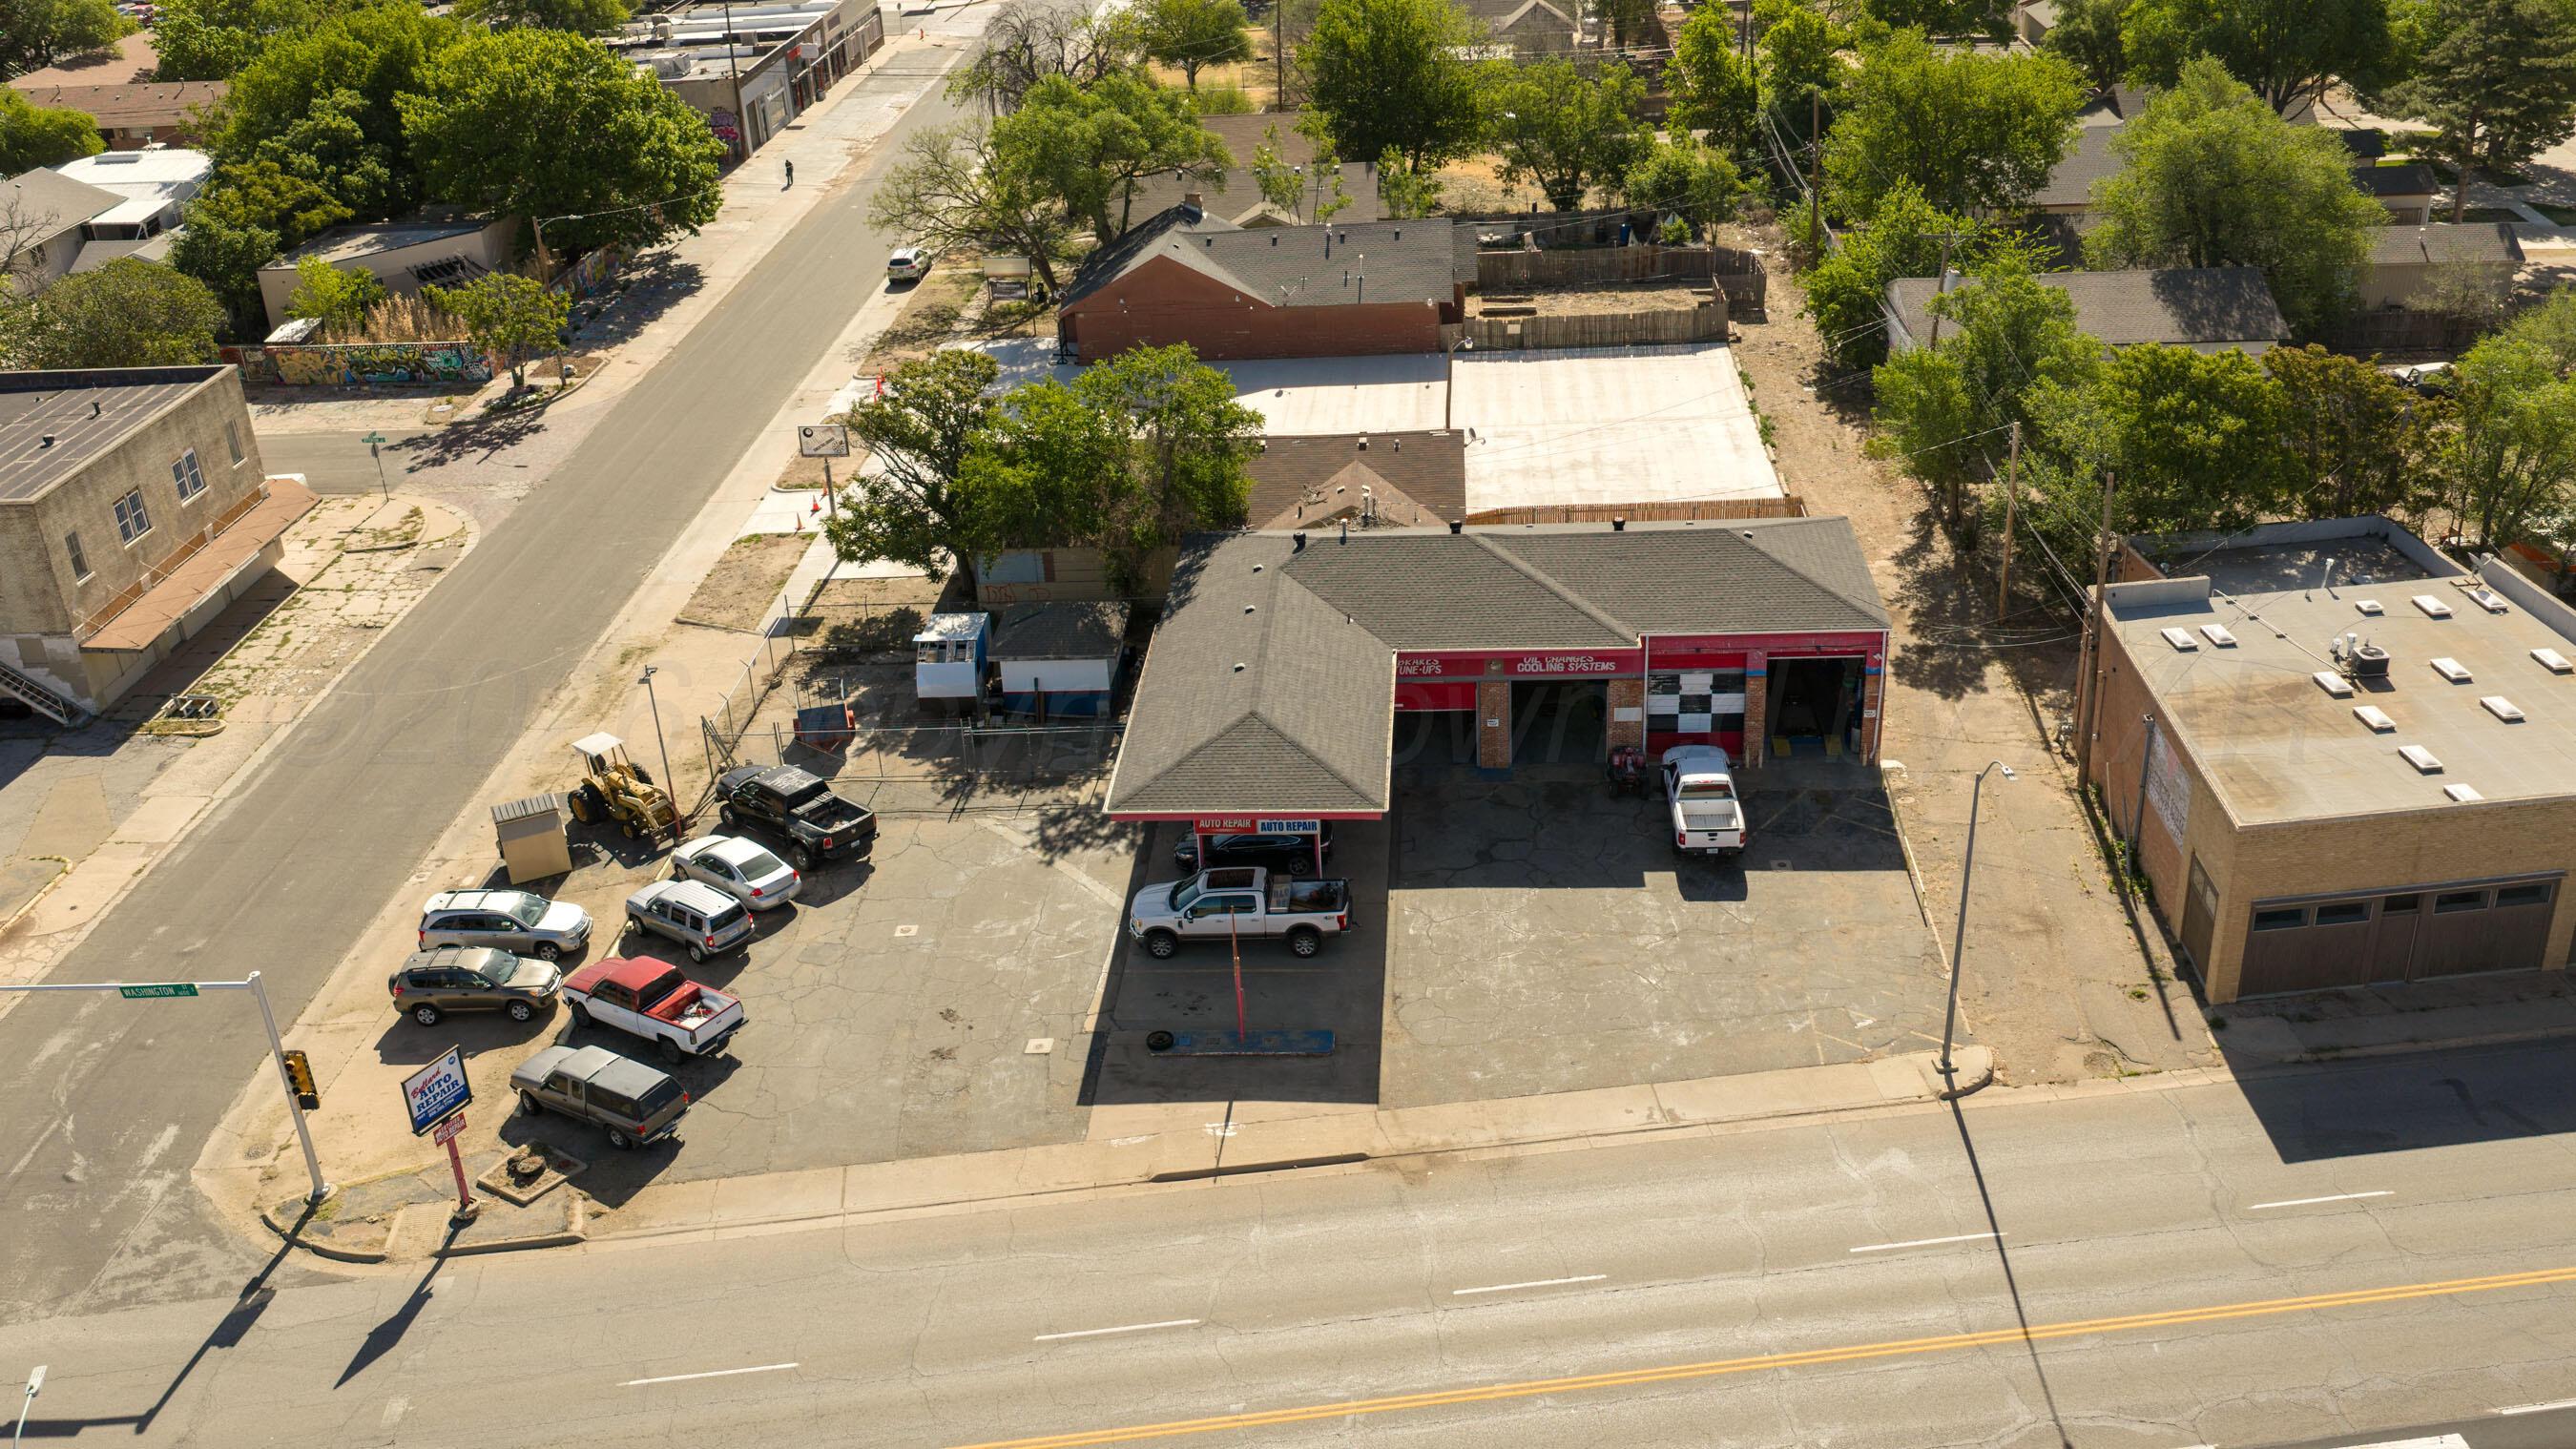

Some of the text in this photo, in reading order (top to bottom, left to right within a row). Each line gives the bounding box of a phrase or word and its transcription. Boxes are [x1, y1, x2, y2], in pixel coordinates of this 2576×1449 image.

[1397, 665, 1443, 675] UNE-UPS
[1517, 661, 1616, 673] COOLING SYSTEMS
[1198, 818, 1252, 828] AUTO REPAIR
[1260, 820, 1318, 832] AUTO REPAIR
[122, 985, 176, 997] WASHINGTON
[420, 1073, 451, 1100] AUTO
[416, 1079, 459, 1112] REPAIR
